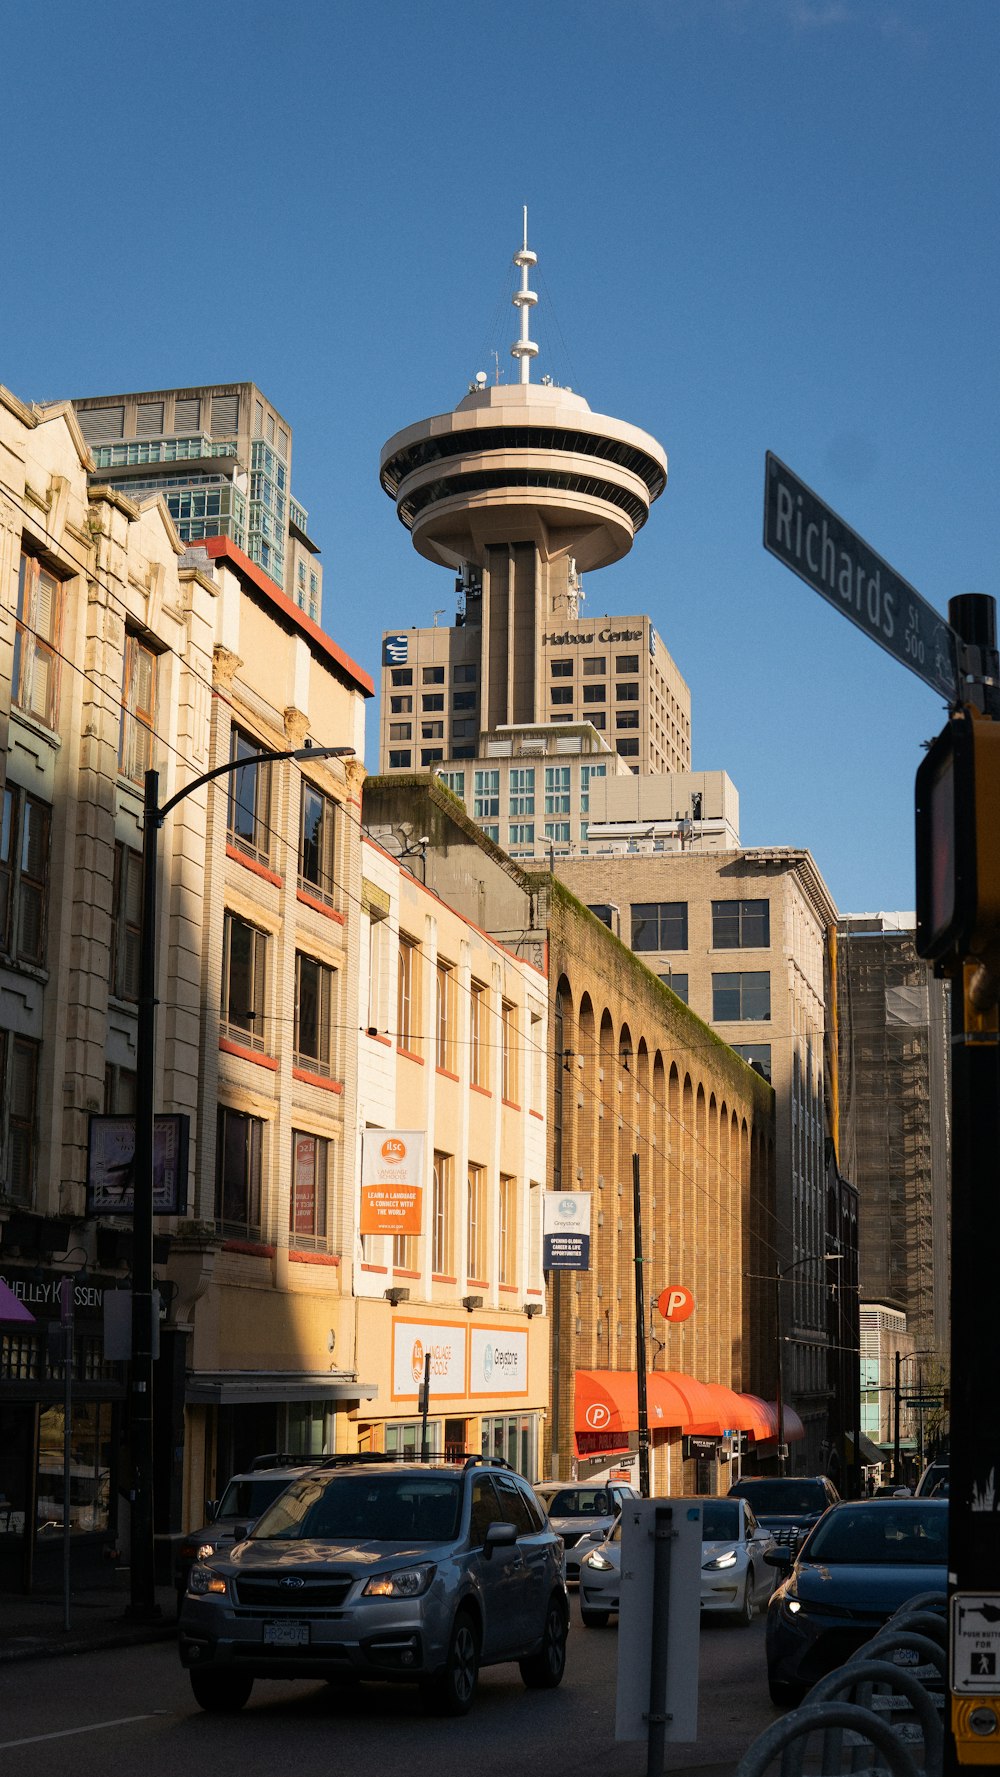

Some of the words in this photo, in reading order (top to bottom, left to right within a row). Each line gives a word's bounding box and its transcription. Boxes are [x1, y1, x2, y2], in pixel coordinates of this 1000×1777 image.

[776, 484, 894, 638] Richards
[908, 604, 920, 634] St
[542, 631, 595, 647] Harbour
[598, 628, 642, 643] Centre
[905, 630, 925, 665] 500
[52, 1281, 102, 1306] KSSEN
[666, 1292, 686, 1316] P
[494, 1348, 518, 1369] Greystone
[593, 1409, 604, 1424] P
